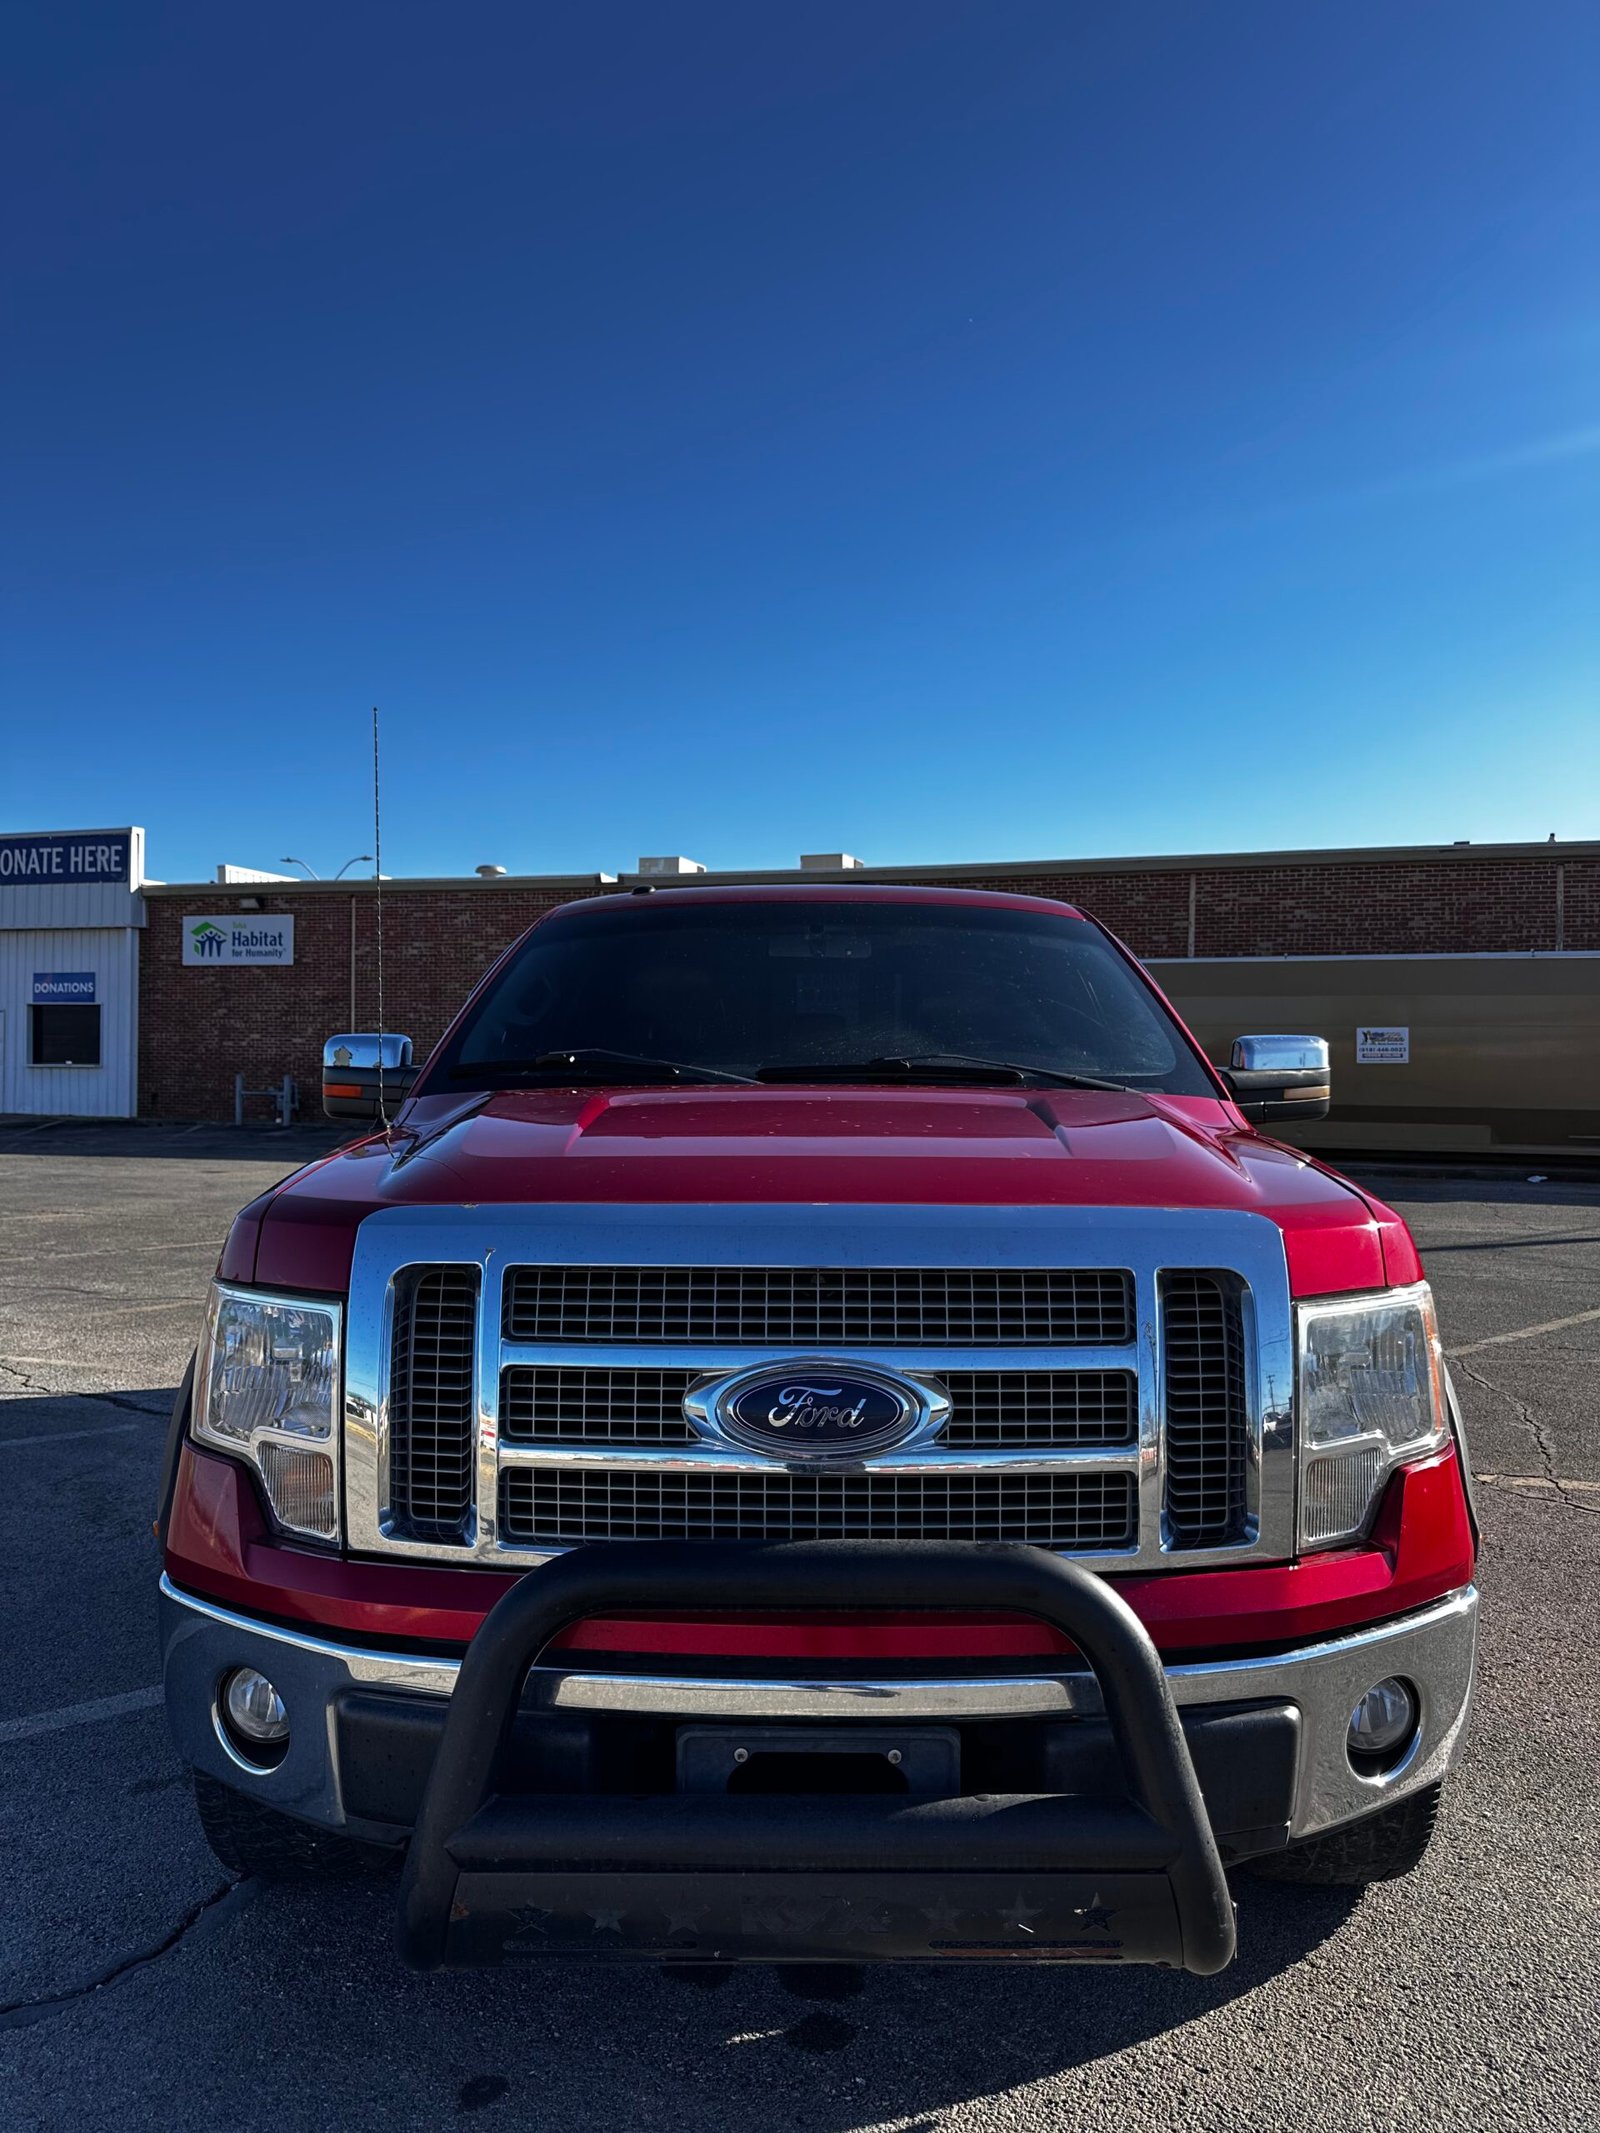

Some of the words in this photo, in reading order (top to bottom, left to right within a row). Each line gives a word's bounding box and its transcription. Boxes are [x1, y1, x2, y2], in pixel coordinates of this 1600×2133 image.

[0, 847, 64, 876] ONATE
[70, 845, 123, 874] HERE
[232, 931, 284, 948] Habitat
[232, 948, 243, 958] for
[245, 948, 283, 960] Humanity
[34, 982, 94, 994] DONATIONS
[767, 1386, 865, 1428] Ford
